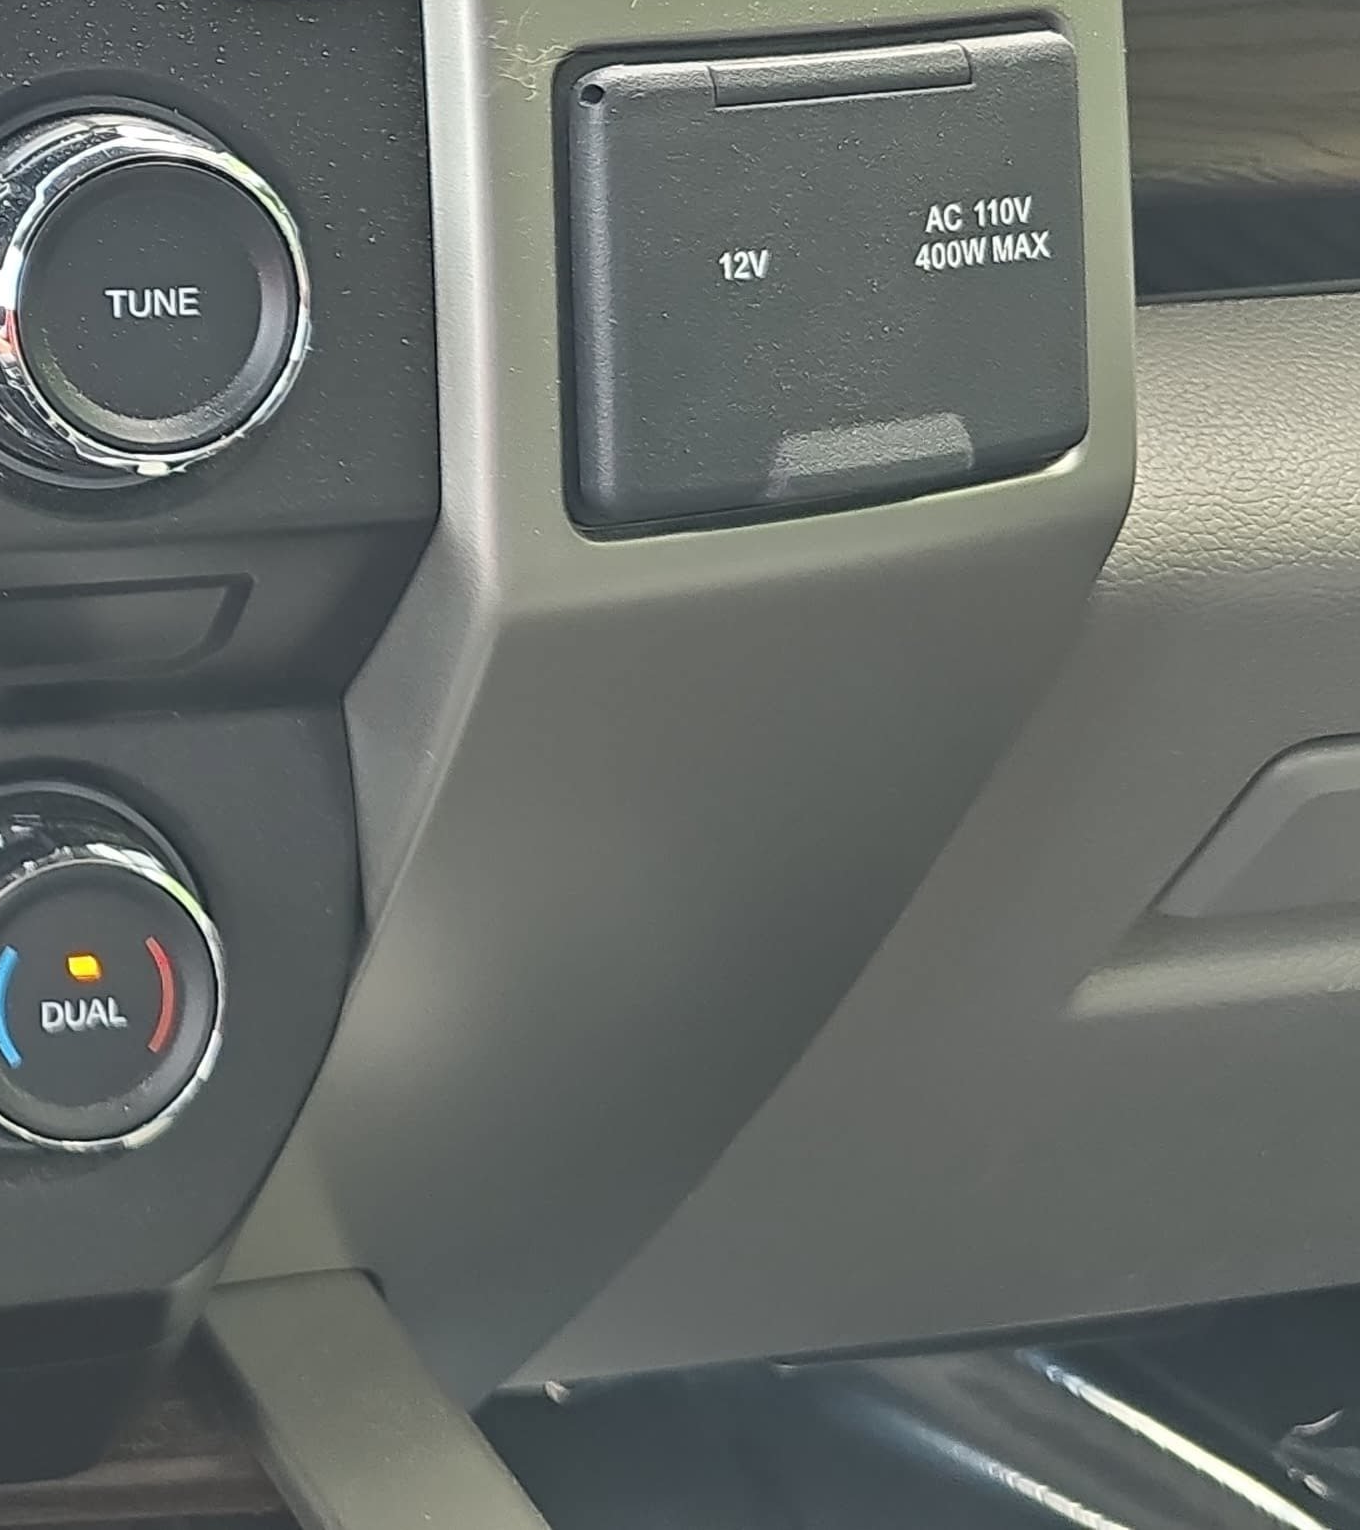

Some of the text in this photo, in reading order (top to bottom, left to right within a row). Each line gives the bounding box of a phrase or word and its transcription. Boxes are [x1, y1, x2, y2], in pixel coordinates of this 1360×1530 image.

[925, 195, 1032, 234] AC 110V
[718, 249, 770, 280] 12V
[914, 230, 1052, 270] 400W MAX
[105, 287, 201, 319] TUNE
[40, 997, 127, 1032] DUAL
